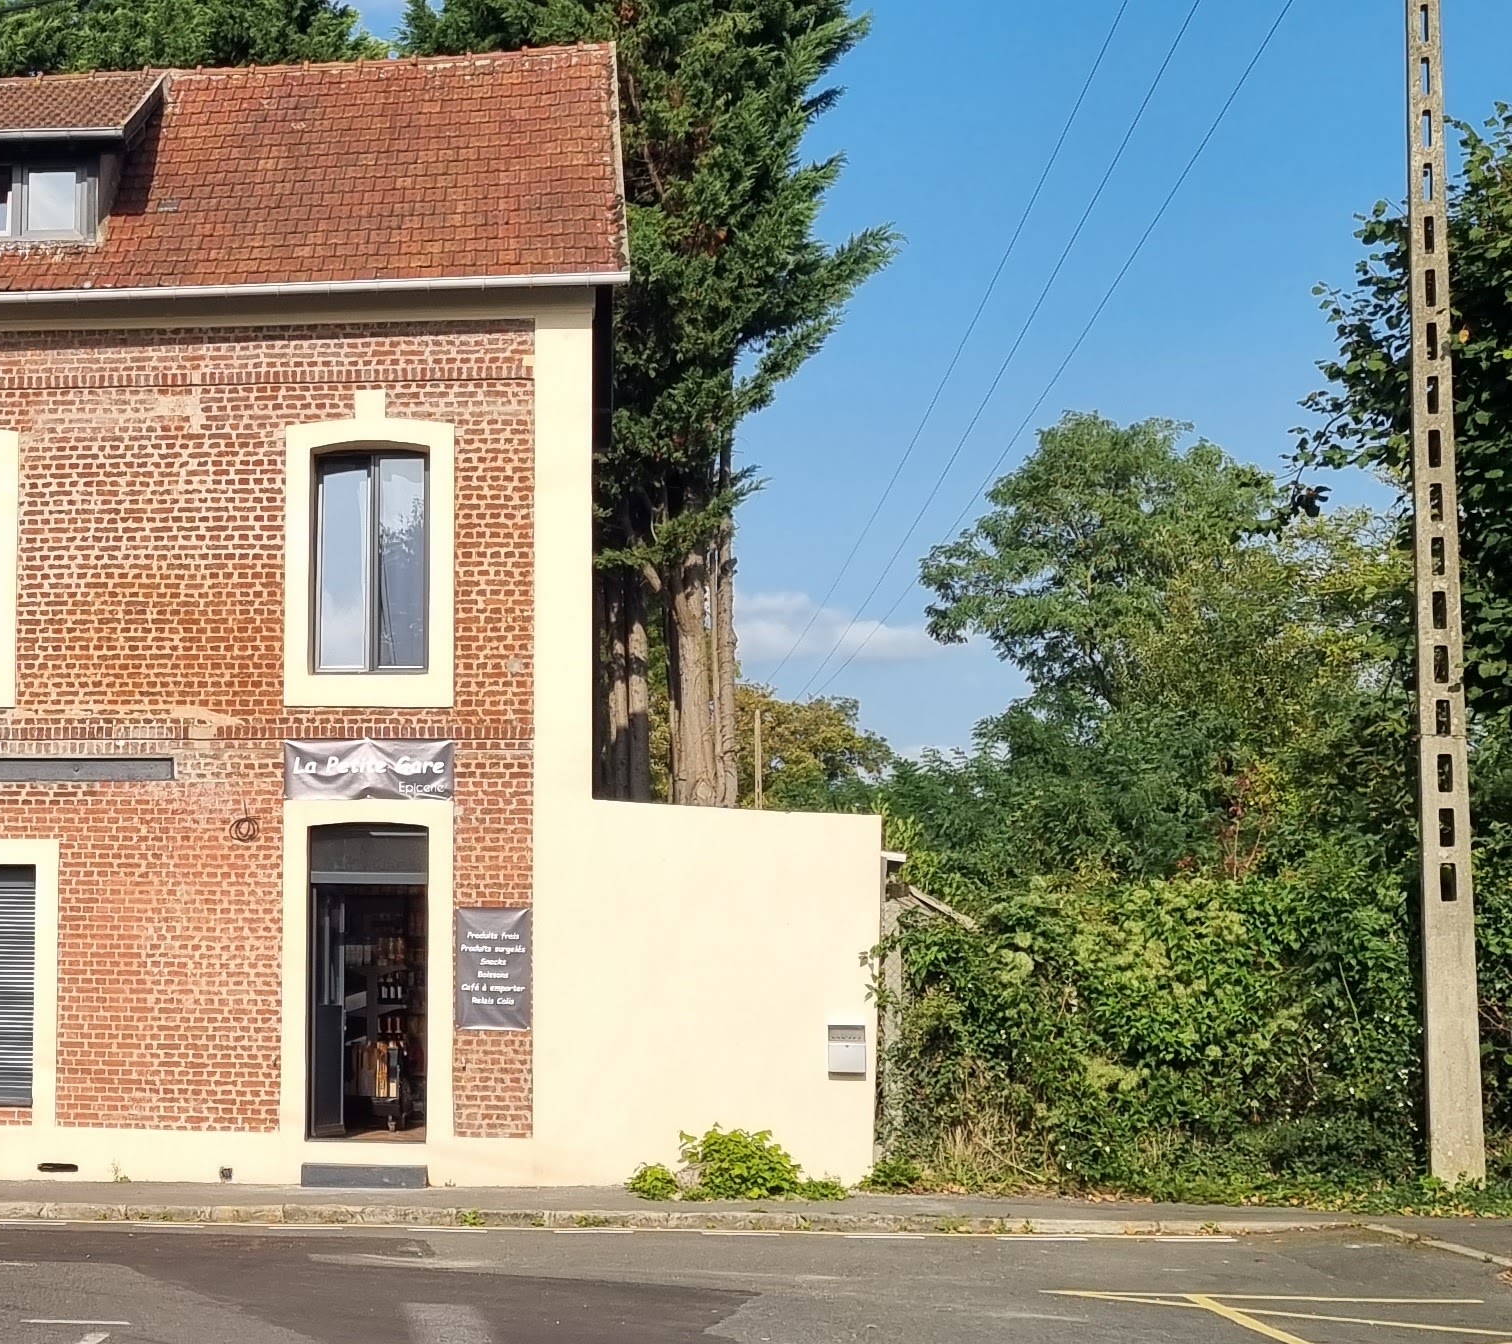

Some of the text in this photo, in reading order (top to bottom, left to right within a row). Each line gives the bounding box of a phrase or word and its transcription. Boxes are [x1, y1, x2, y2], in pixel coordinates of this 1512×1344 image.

[293, 756, 445, 774] La Petite Gare
[398, 781, 445, 794] Epicerie
[467, 931, 520, 941] Produits frais
[460, 944, 527, 955] Produits surgelés
[479, 957, 507, 966] Snacks
[477, 970, 509, 979] Boissons
[461, 983, 526, 994] Café à emporter
[471, 997, 515, 1006] Relais Colis
